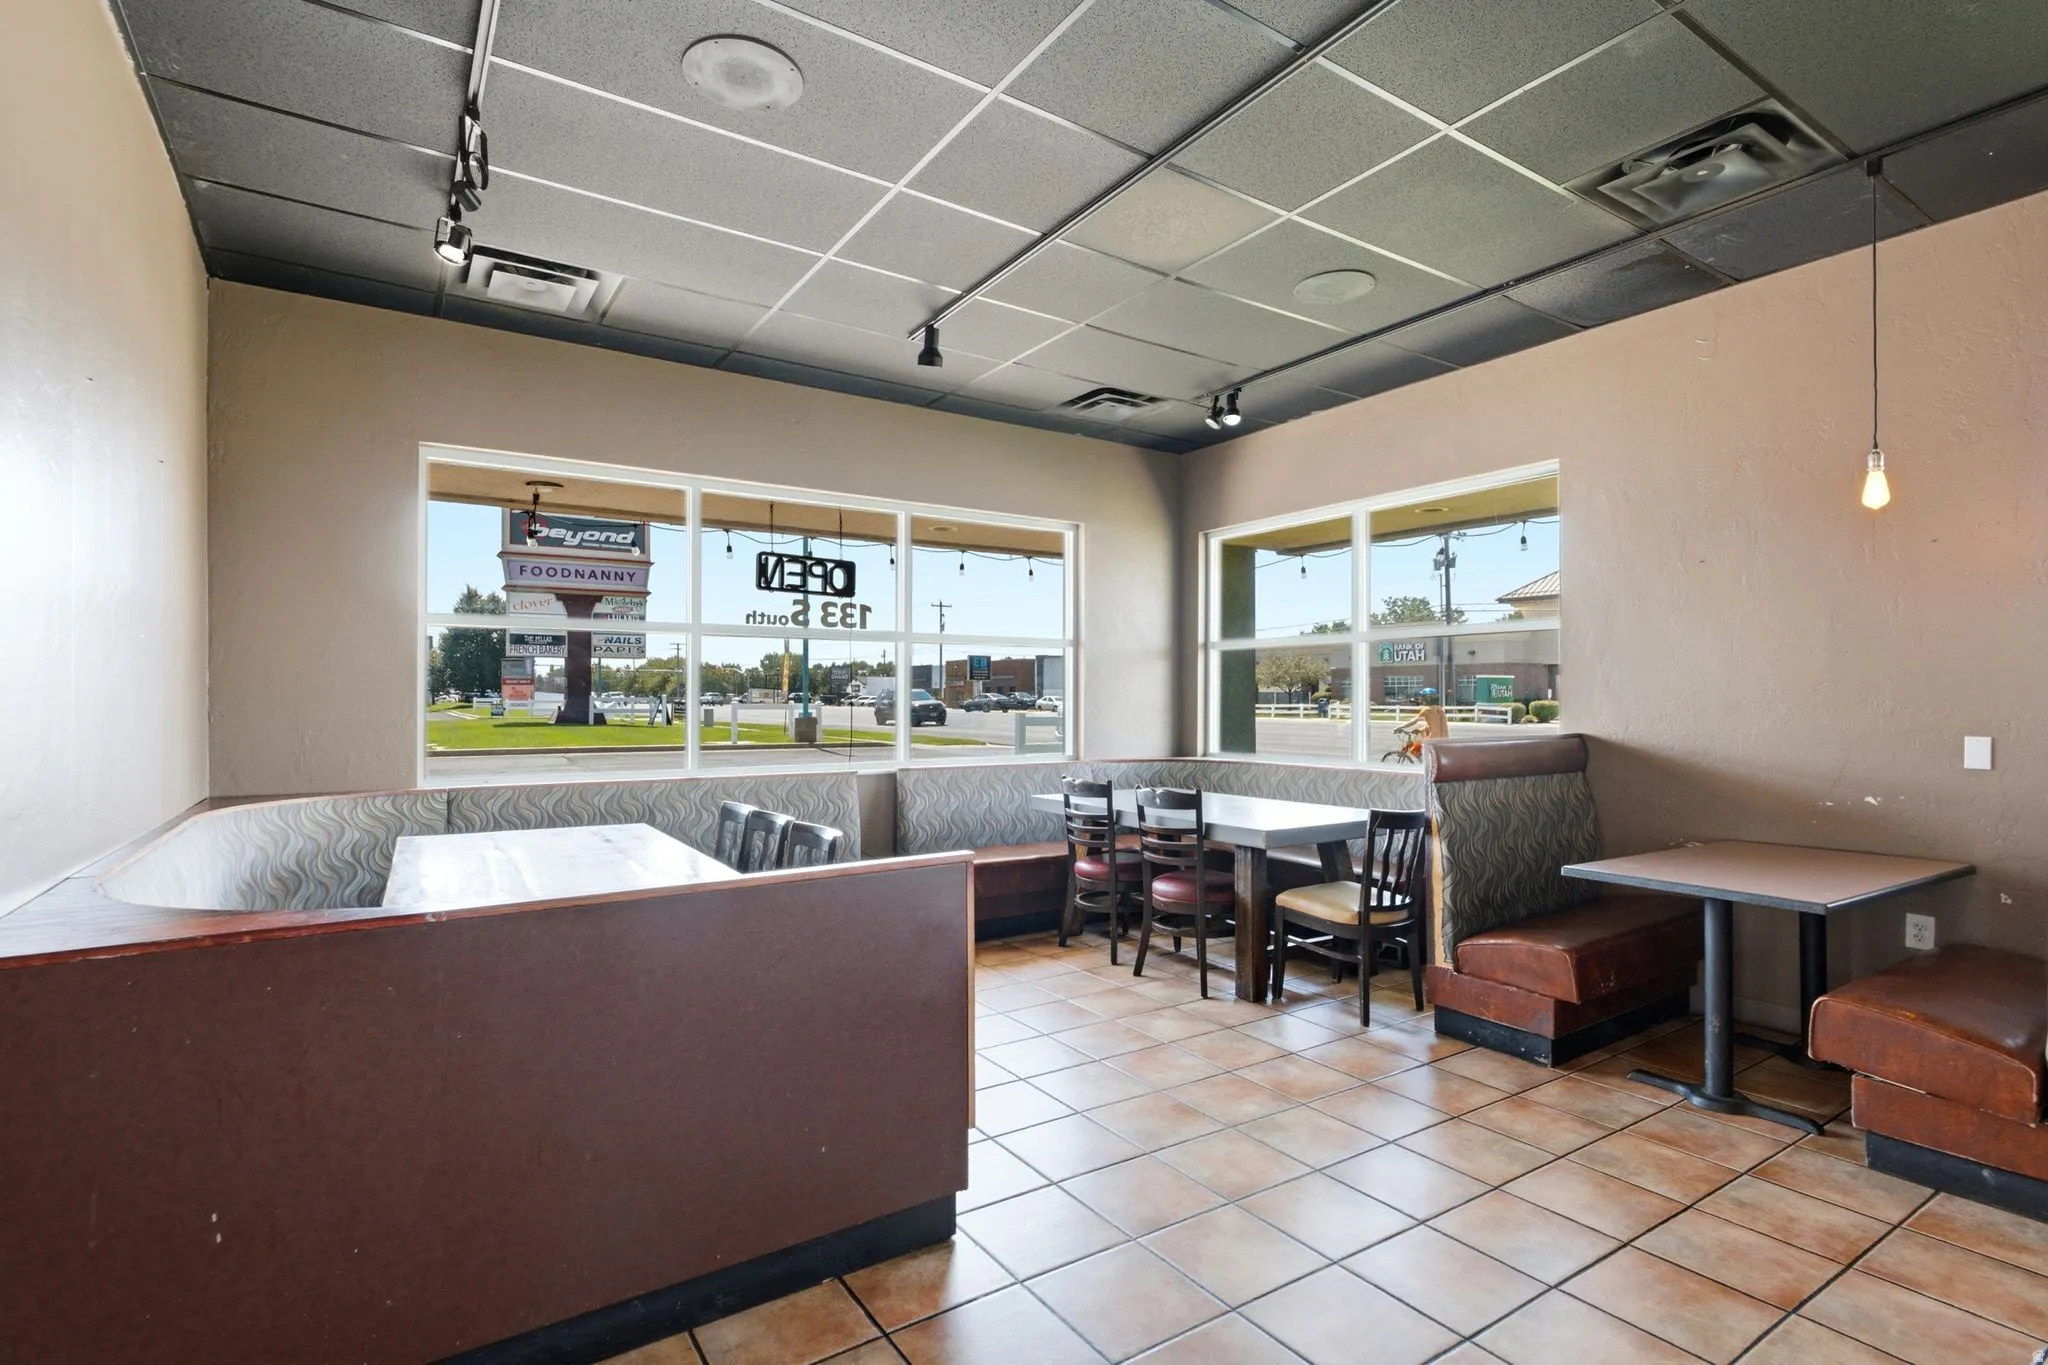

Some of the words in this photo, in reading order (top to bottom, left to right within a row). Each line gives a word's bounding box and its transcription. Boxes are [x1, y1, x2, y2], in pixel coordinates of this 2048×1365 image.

[530, 523, 635, 546] beyond
[519, 565, 637, 582] FOODNANNY
[604, 636, 642, 645] NAILS
[509, 644, 537, 654] FRENCH
[539, 645, 567, 655] BAKERY
[1393, 649, 1426, 661] UTAH
